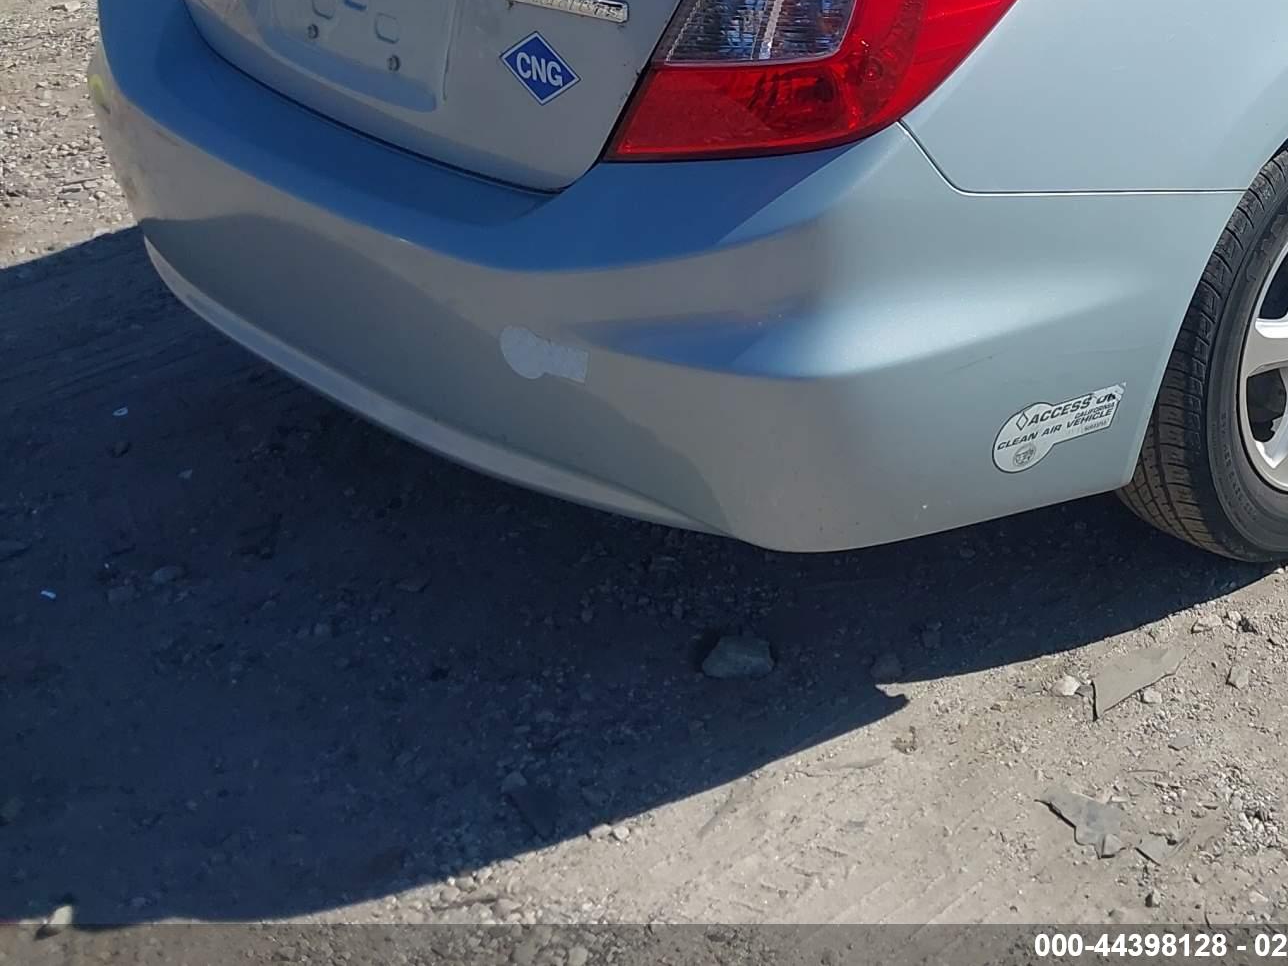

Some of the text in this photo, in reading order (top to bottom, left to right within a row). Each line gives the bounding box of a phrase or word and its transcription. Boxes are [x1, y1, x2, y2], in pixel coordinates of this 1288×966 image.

[516, 51, 563, 87] CNG
[1028, 395, 1092, 427] ACCESS
[1074, 401, 1115, 420] CALIFORNIA
[997, 431, 1038, 451] CLEAN
[1041, 423, 1063, 437] AIR
[1066, 408, 1113, 429] VEHICLE
